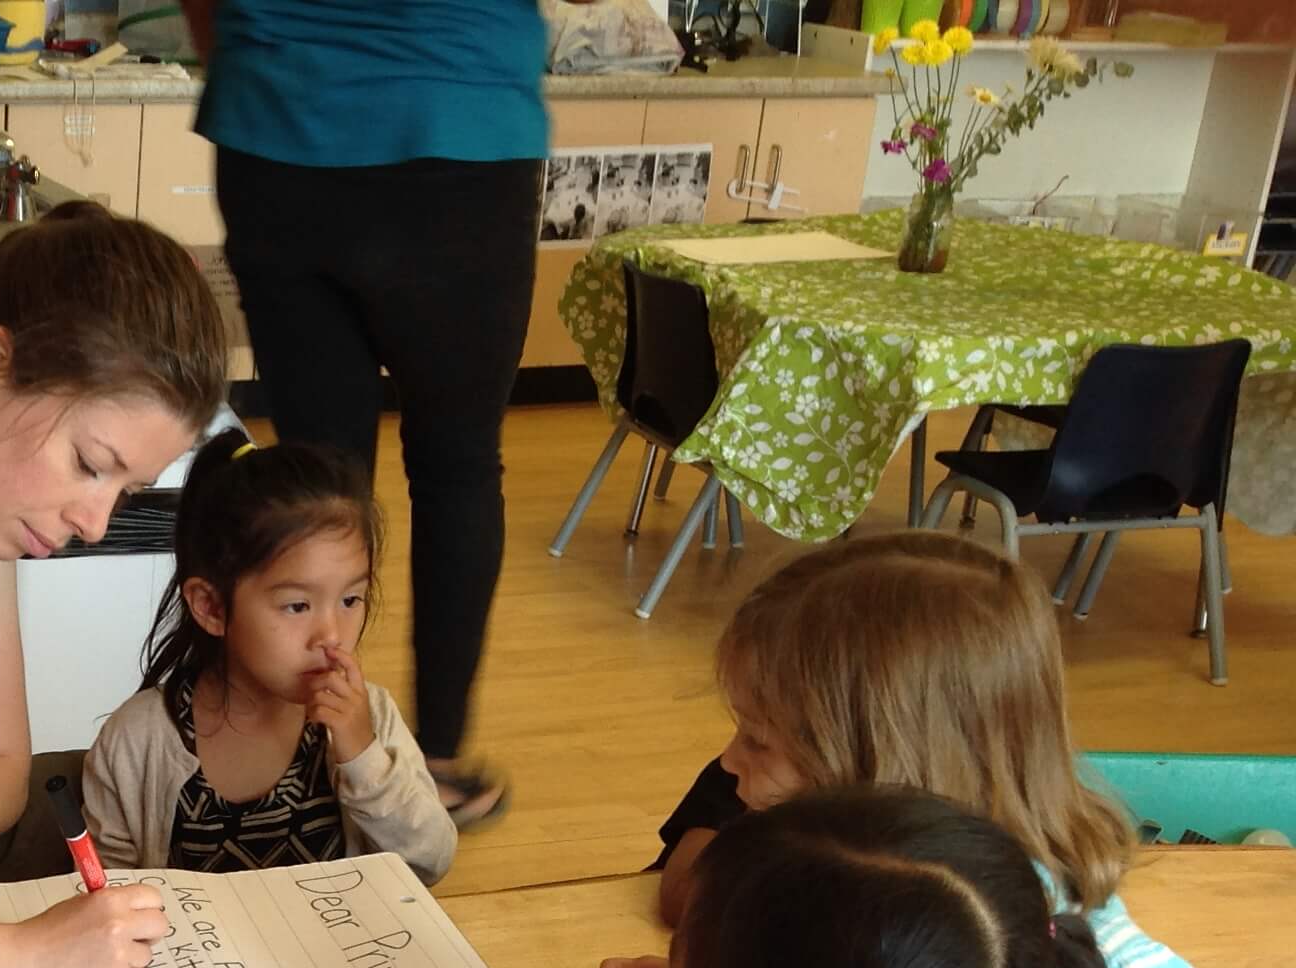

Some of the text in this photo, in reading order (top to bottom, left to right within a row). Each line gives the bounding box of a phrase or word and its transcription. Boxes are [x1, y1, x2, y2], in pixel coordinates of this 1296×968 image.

[171, 887, 212, 914] We
[193, 921, 221, 952] are
[295, 870, 363, 929] Dear
